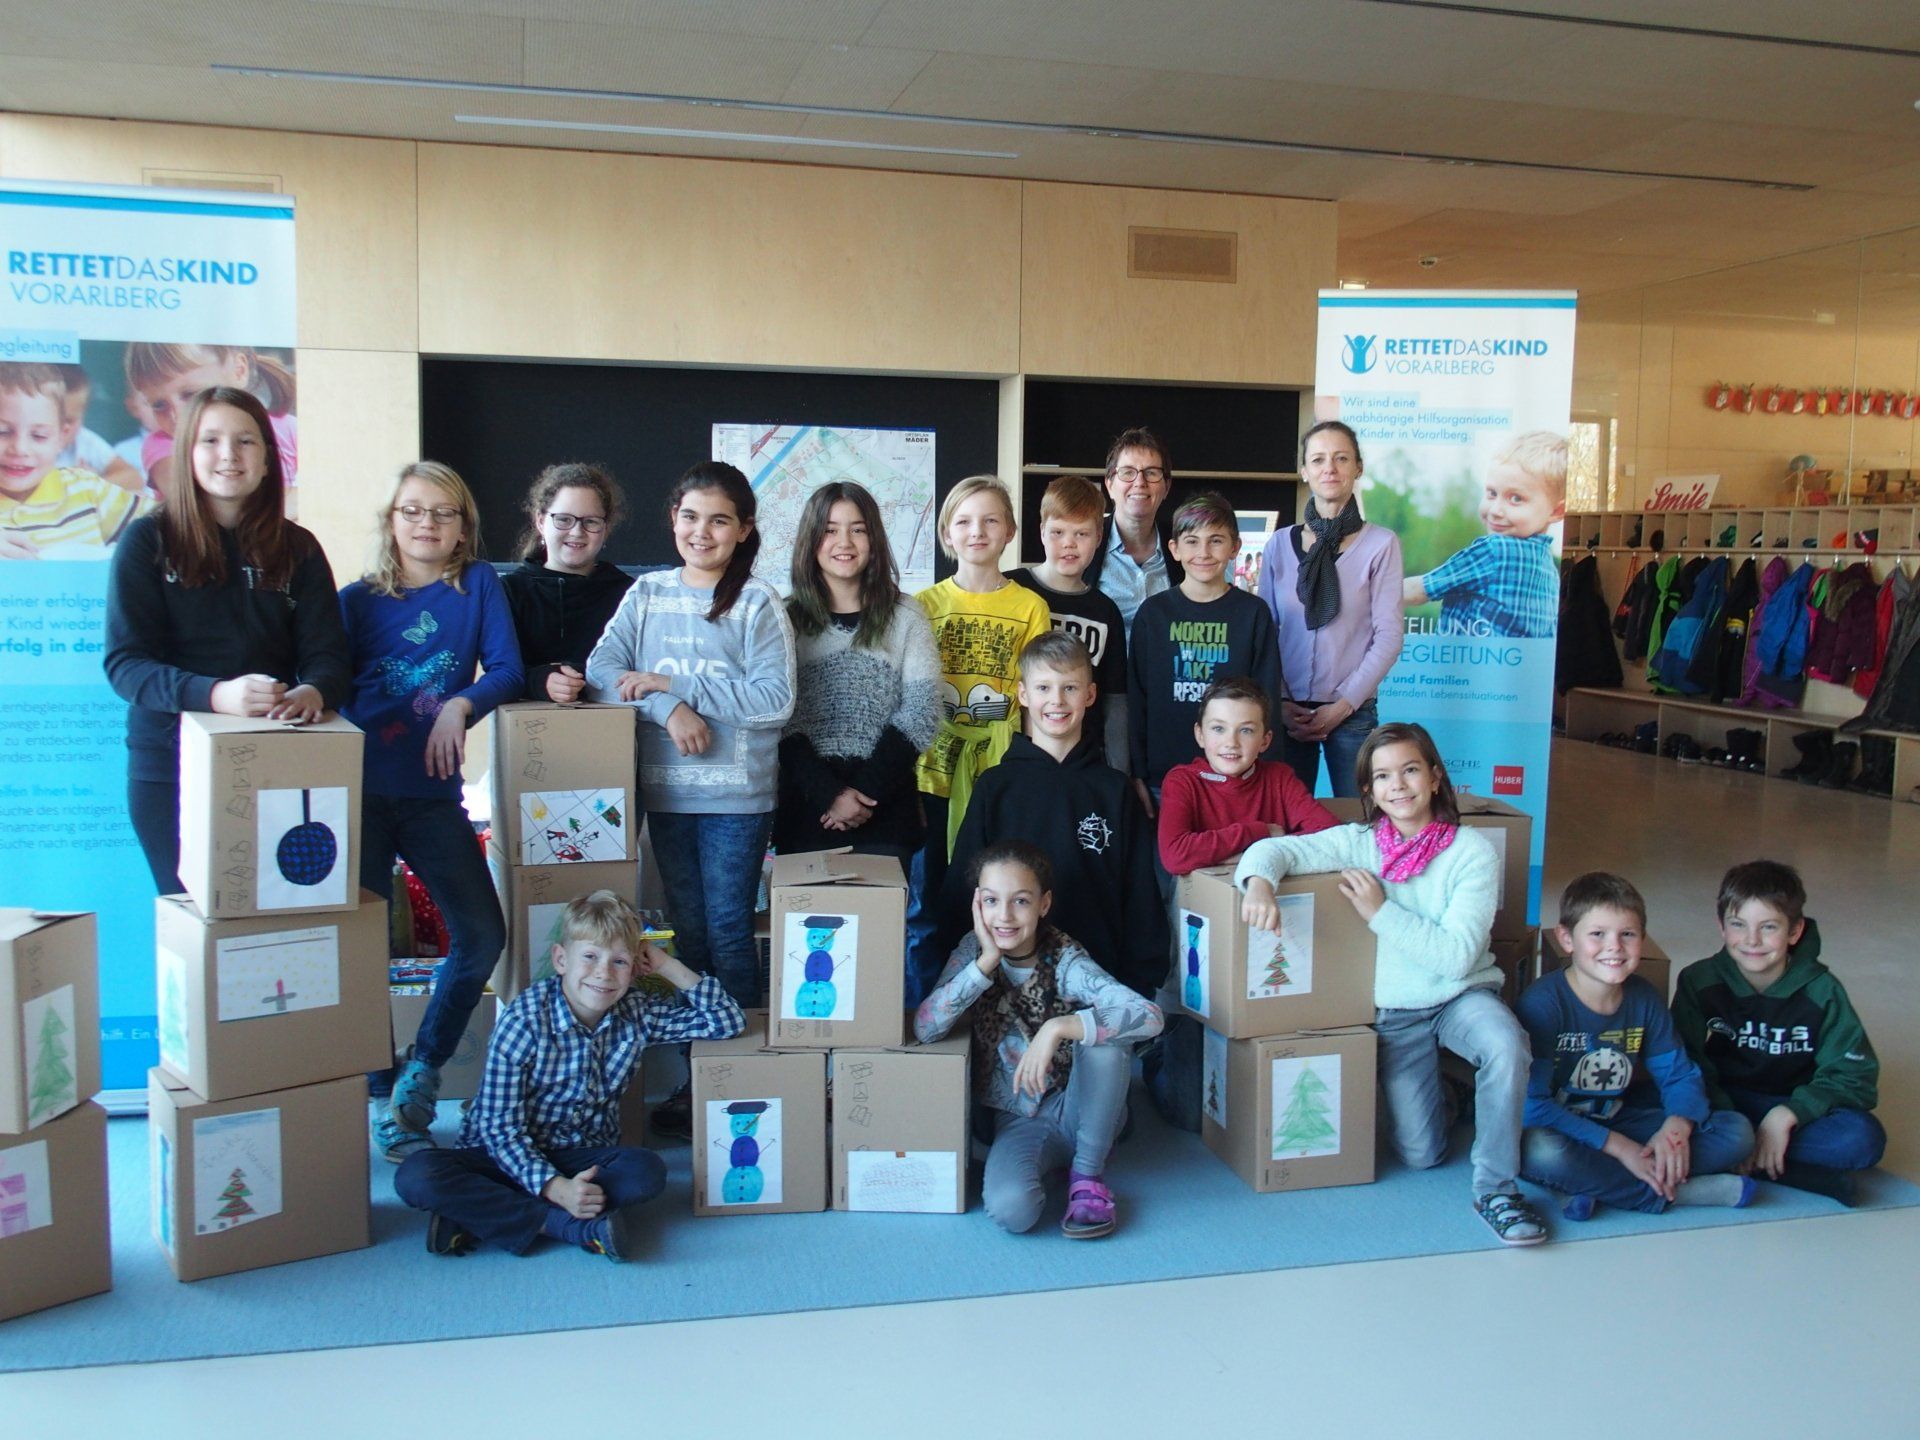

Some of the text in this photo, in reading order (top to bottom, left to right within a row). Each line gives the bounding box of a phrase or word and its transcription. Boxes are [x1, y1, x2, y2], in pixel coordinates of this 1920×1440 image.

[9, 250, 259, 285] RETTETDASKIND
[10, 282, 182, 310] VORARLBERG
[0, 335, 72, 359] egleitung
[1384, 338, 1549, 357] RETTETDASKIND
[1385, 359, 1496, 376] VORARLBERG
[1344, 396, 1417, 408] Wir sind eine
[1343, 412, 1509, 427] unabhängige Hilfsorganisation
[1360, 429, 1394, 440] Kinder
[1399, 429, 1408, 440] in
[1644, 482, 1709, 511] Smile
[46, 592, 106, 612] erfolgre
[8, 616, 43, 630] Kind
[49, 616, 101, 630] wieder
[1404, 616, 1491, 638] ELLUNG
[1170, 622, 1227, 642] NORTH
[0, 637, 105, 656] rfolg in der
[1179, 642, 1229, 664] WOOD
[1400, 644, 1523, 666] EGLEITUNG
[1393, 674, 1416, 684] und
[1419, 675, 1469, 686] Familien
[1430, 689, 1519, 701] Lebenssituationen
[0, 702, 89, 715] ernbegleitung
[0, 720, 41, 732] swege
[1494, 775, 1522, 785] HUBER
[0, 806, 33, 816] uche
[0, 822, 76, 835] inanzierung
[132, 1028, 151, 1040] Ein
[1738, 1020, 1809, 1042] JETS
